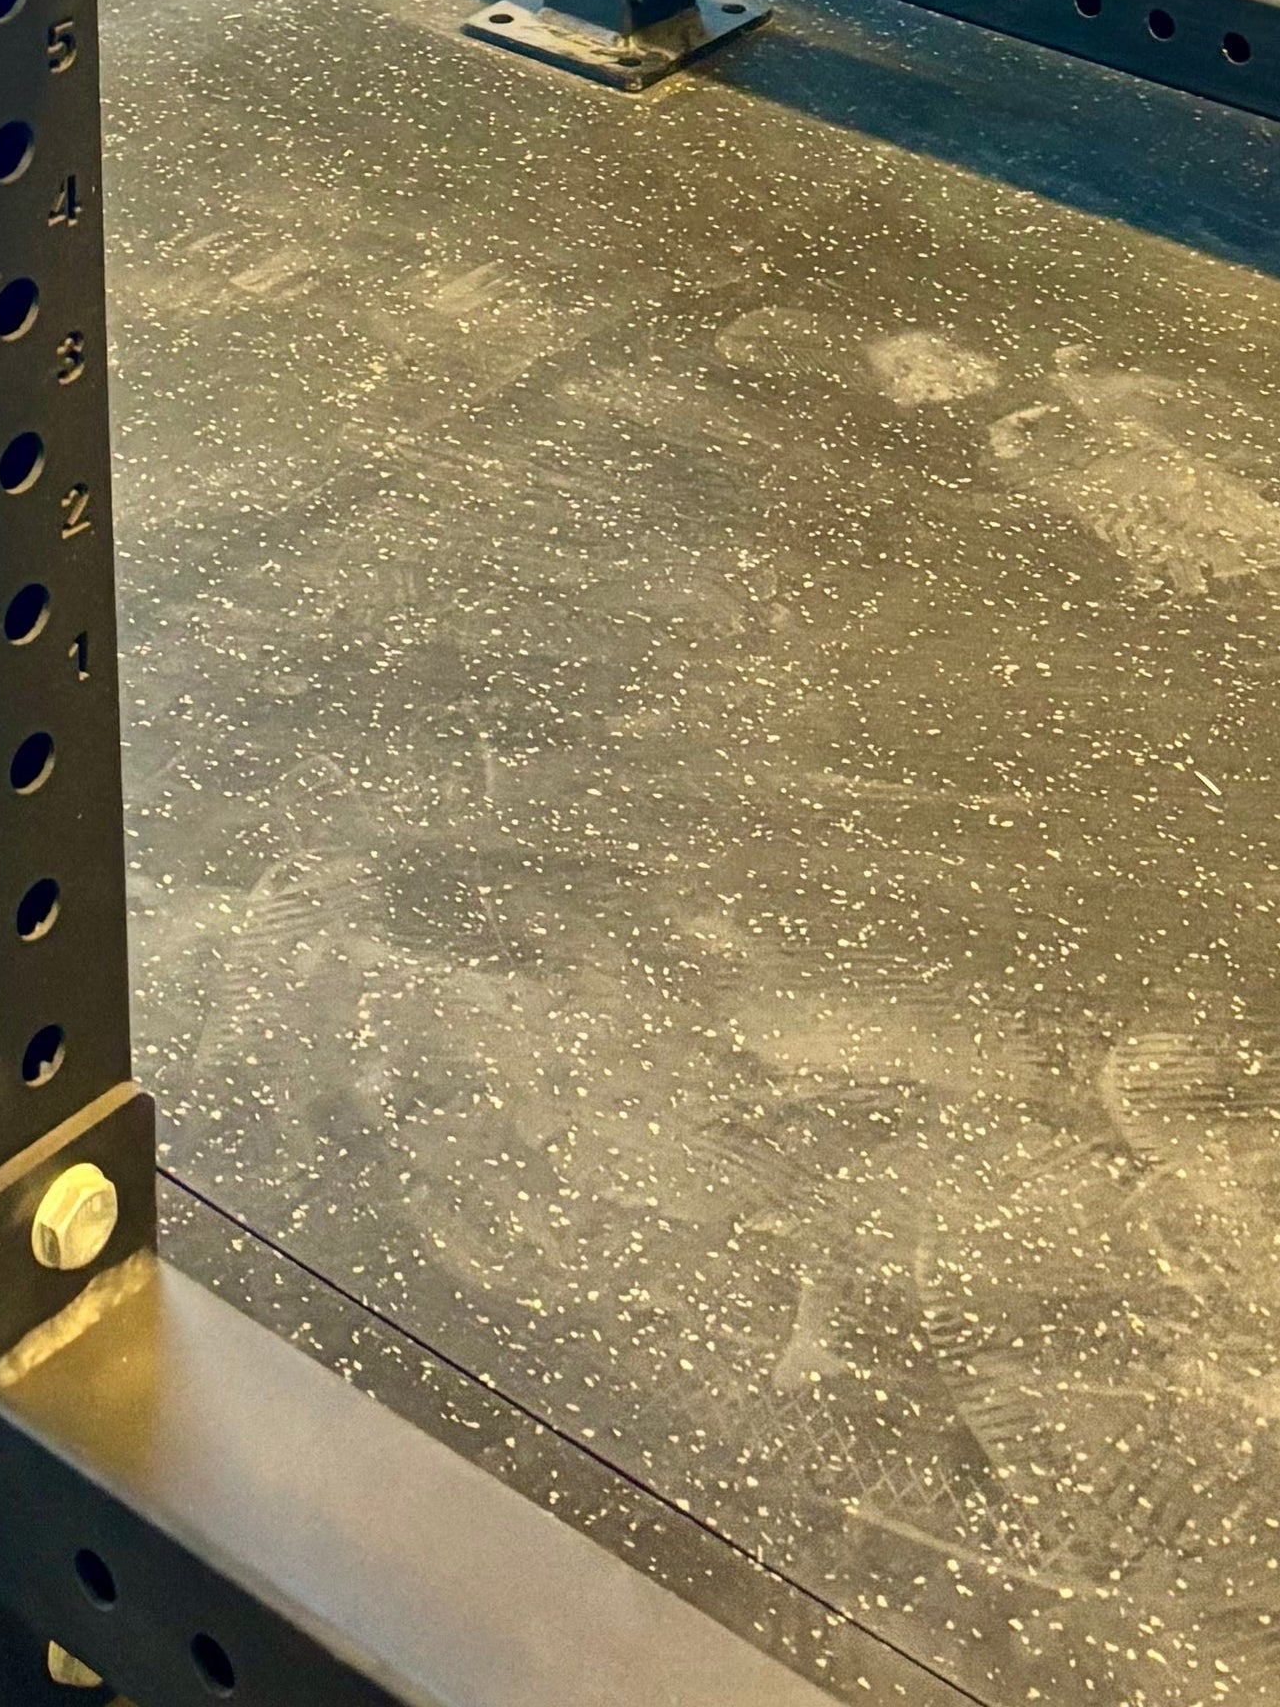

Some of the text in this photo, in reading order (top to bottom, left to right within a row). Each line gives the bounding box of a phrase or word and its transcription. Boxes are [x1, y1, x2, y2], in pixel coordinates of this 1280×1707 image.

[47, 18, 78, 75] 5
[48, 176, 82, 229] 4
[57, 332, 86, 386] 3
[61, 483, 94, 541] 2
[67, 631, 91, 681] 1
